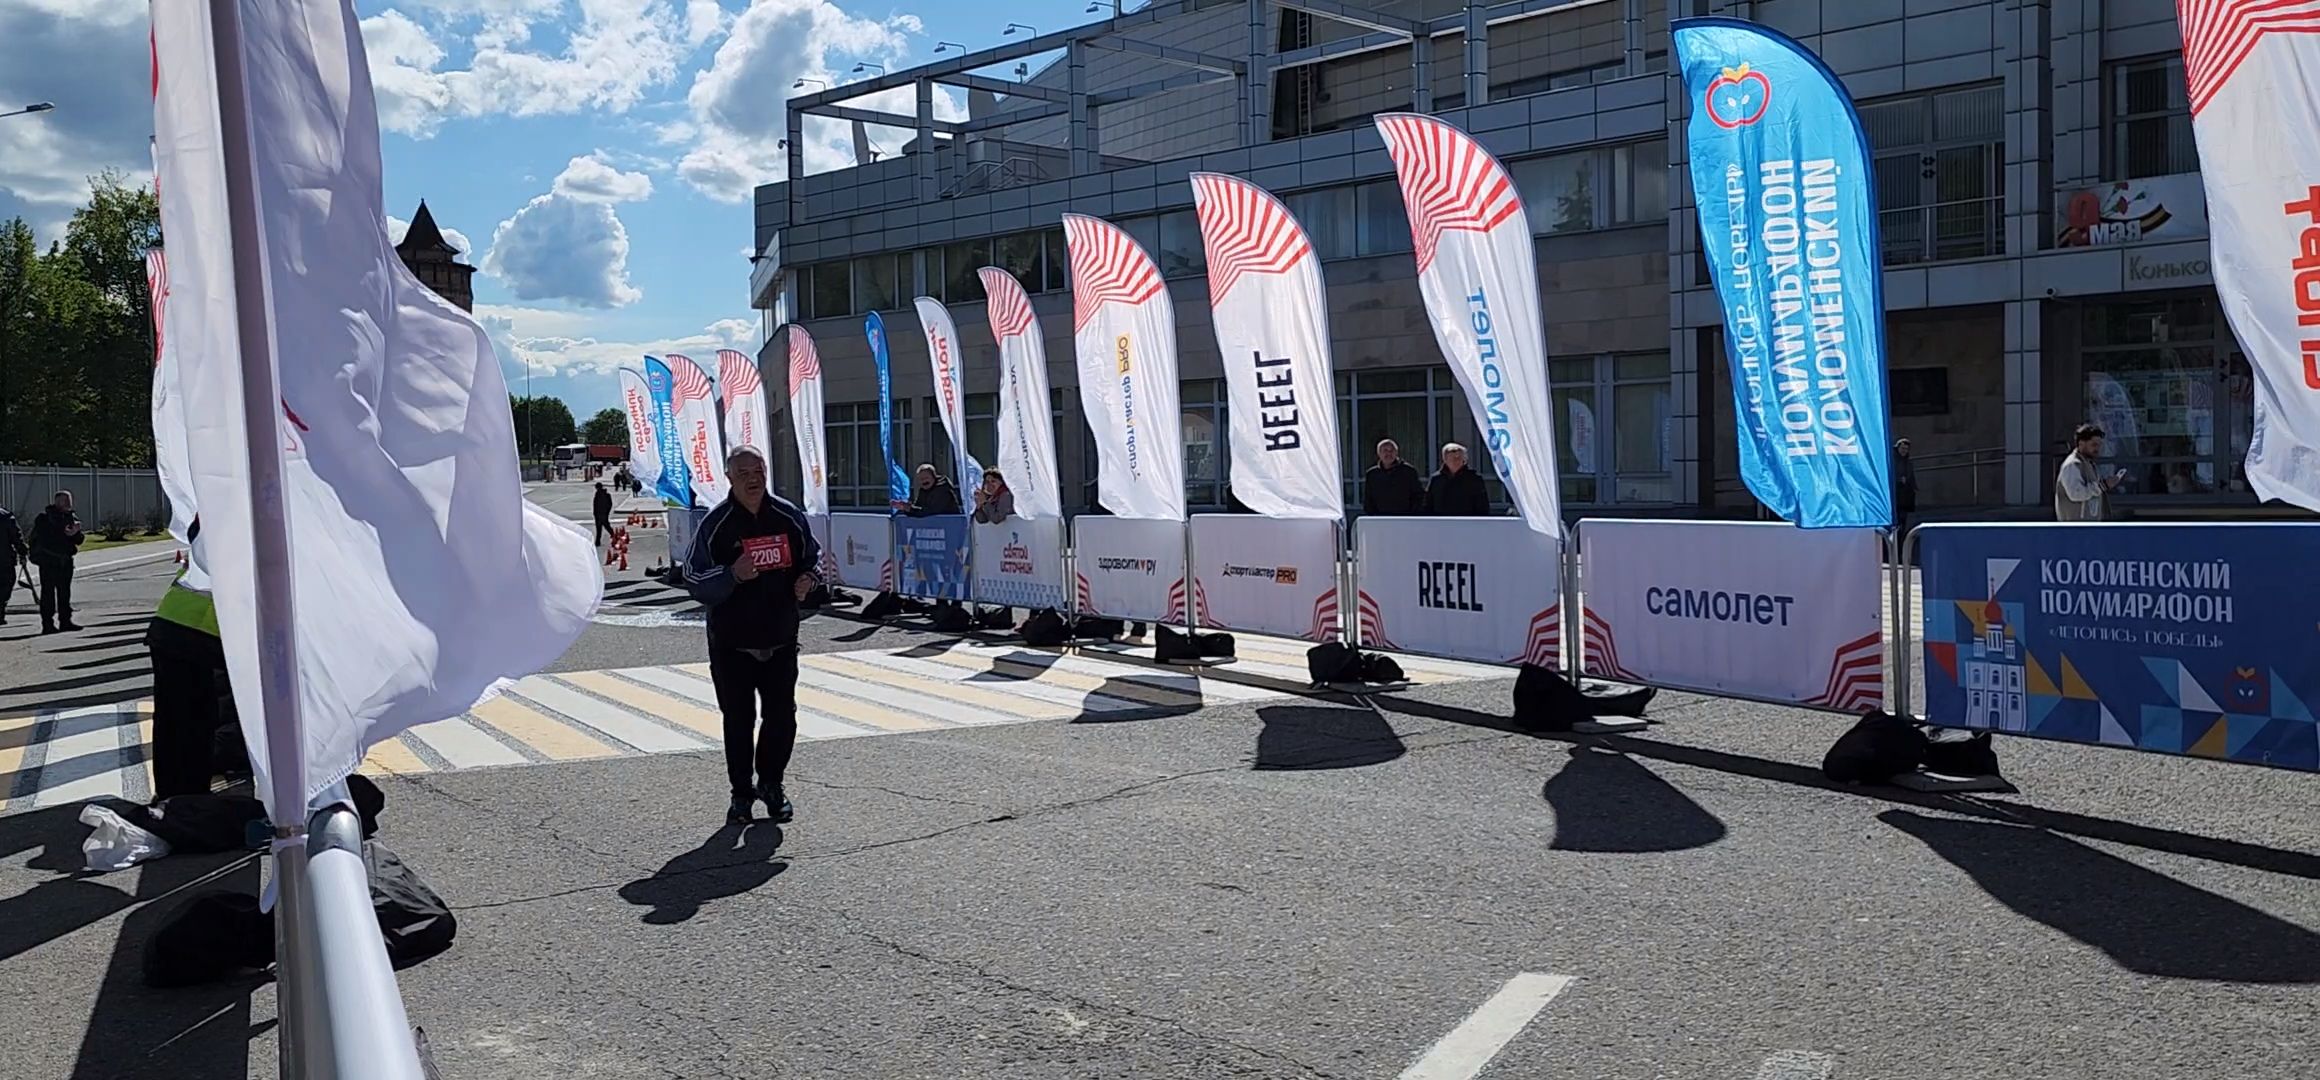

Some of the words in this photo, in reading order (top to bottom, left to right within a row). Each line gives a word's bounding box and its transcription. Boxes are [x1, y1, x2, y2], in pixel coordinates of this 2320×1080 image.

[2129, 255, 2208, 281] Конько
[751, 547, 781, 566] 2209
[1275, 569, 1297, 582] PRO
[1418, 561, 1483, 611] REEEL
[2040, 558, 2231, 590] КОЛОМЕНСКИЙ
[1646, 585, 1794, 627] самолет
[2040, 589, 2234, 623] ПОЛУМАРАФОН
